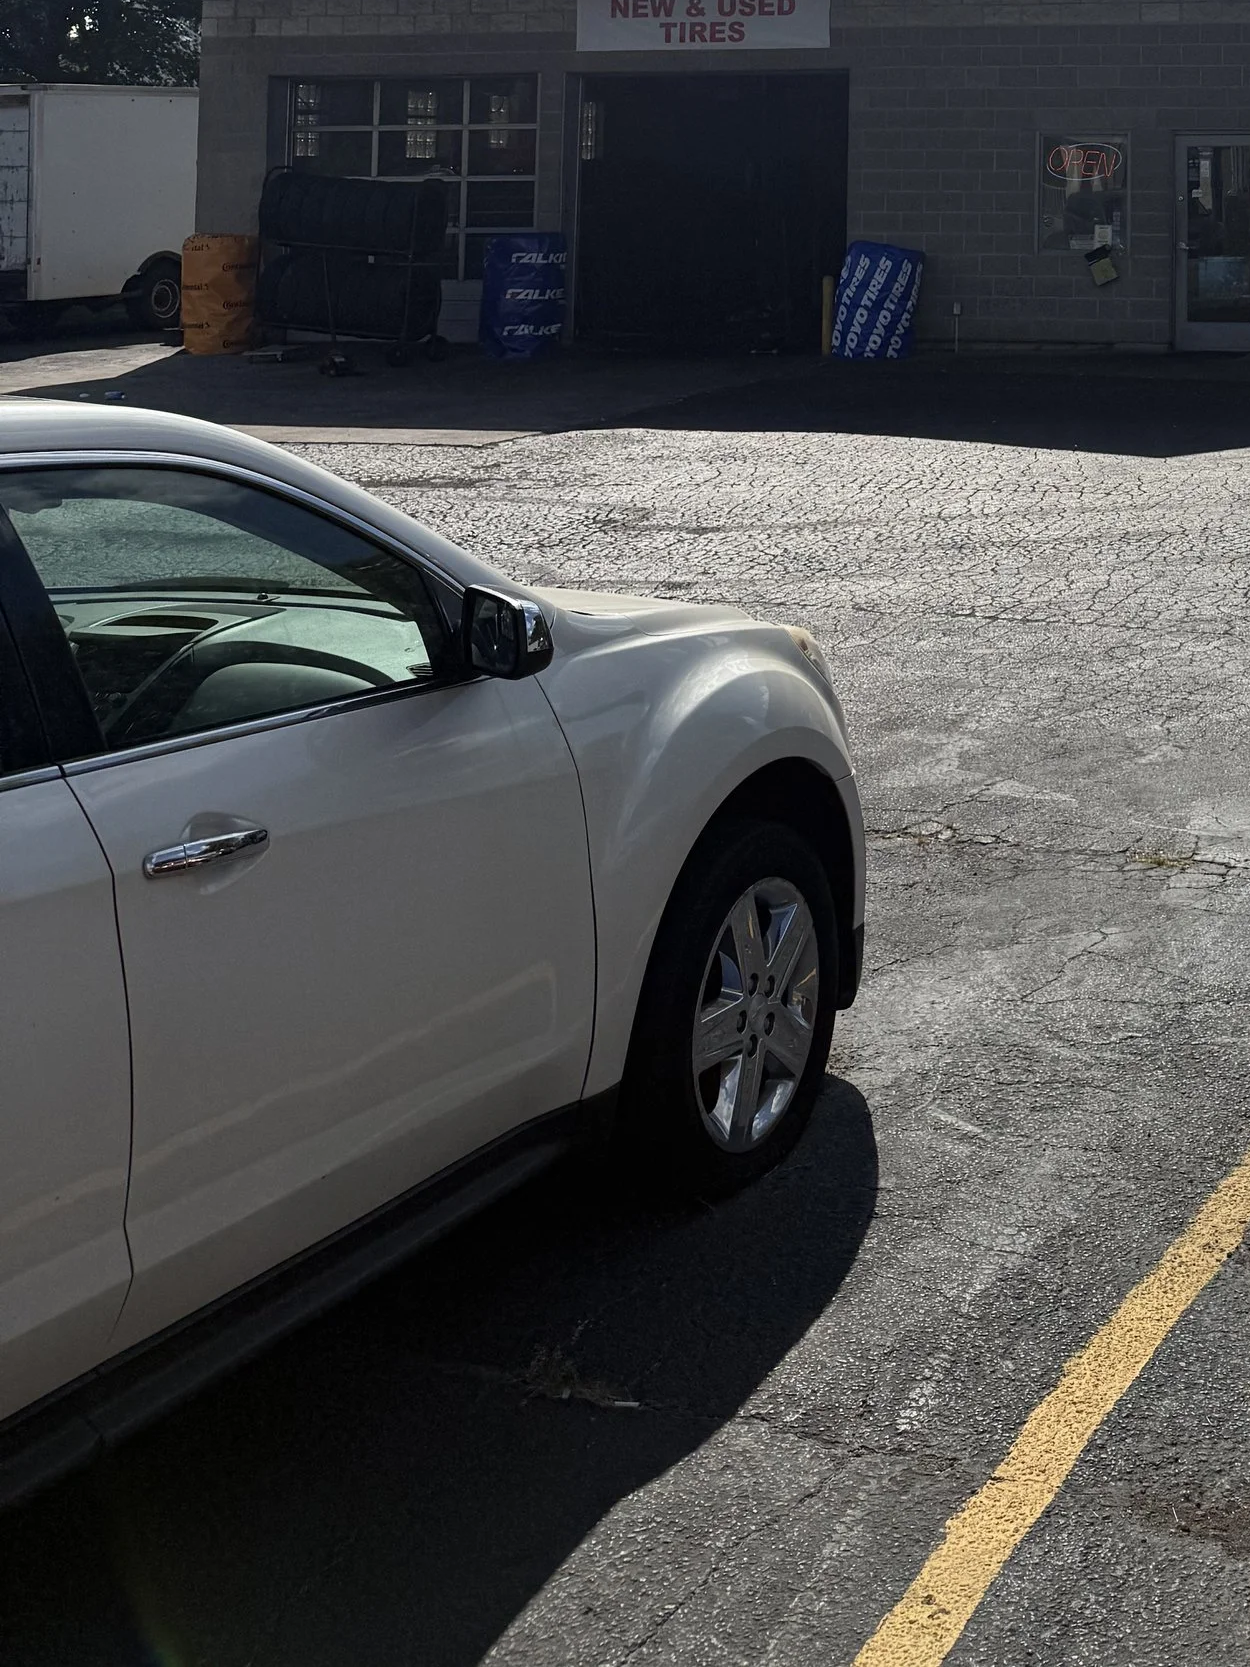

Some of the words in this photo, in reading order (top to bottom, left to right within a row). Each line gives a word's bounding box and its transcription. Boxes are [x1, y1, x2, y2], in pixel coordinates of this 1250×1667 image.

[659, 21, 746, 44] TIRES
[1048, 145, 1117, 178] OPEN
[841, 253, 871, 306] TIRES
[860, 255, 893, 309] TIRES
[883, 258, 913, 311] TIRES
